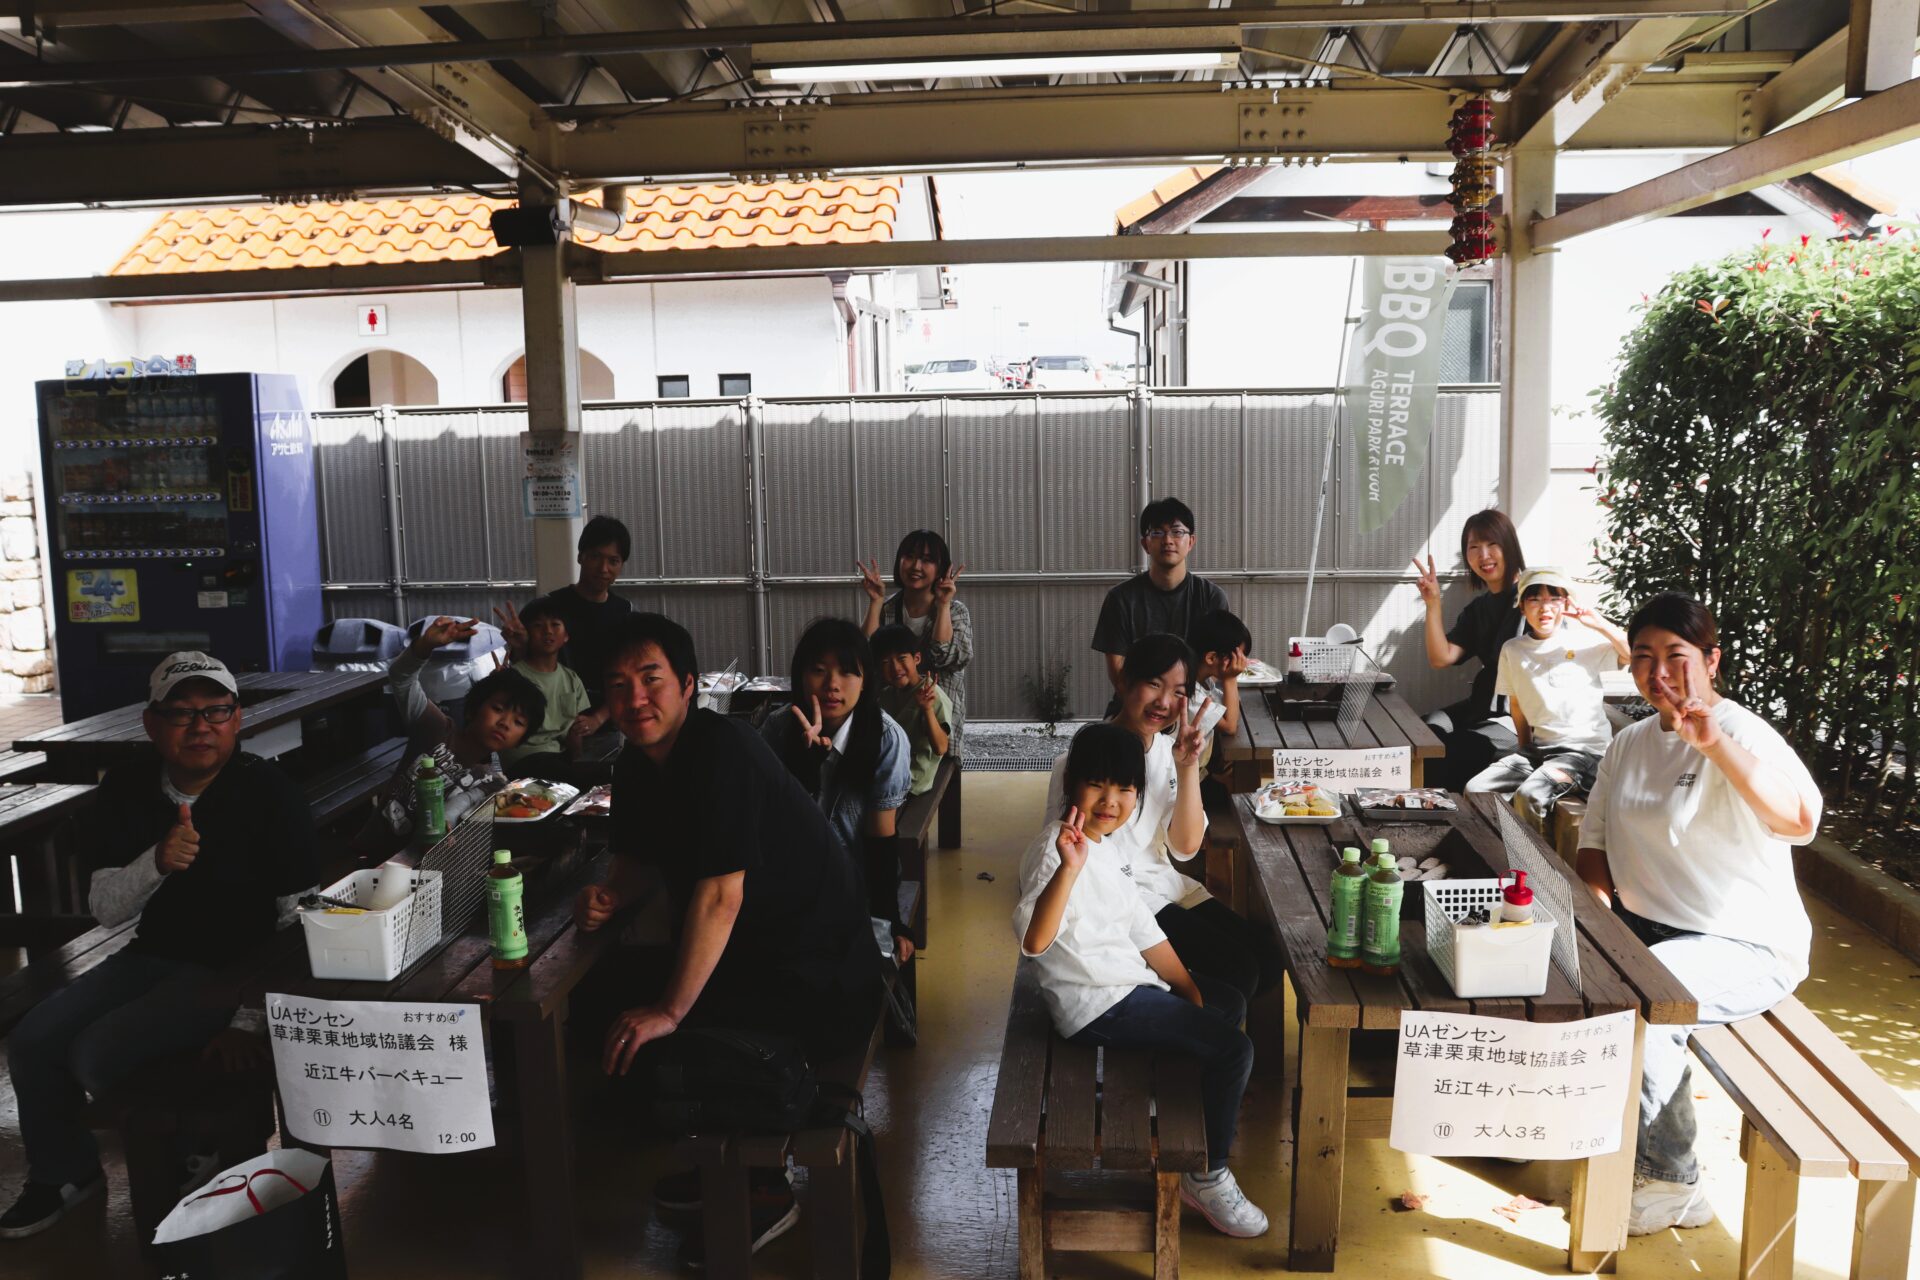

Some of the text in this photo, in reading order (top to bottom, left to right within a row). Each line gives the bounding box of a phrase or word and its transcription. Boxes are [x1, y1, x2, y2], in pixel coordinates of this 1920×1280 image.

[1364, 264, 1435, 358] BBQ
[1368, 369, 1388, 414] AGURI
[1385, 370, 1415, 467] TERRACE
[1368, 418, 1383, 455] PARK
[1276, 757, 1333, 767] UAゼンセン
[1277, 766, 1402, 779] 草津栗東地域協議会 様
[271, 1006, 354, 1028] UAゼンセン
[273, 1025, 468, 1052] 草津栗東地域協議会 様
[1405, 1024, 1506, 1043] UAゼンセン
[1403, 1042, 1618, 1068] 草津栗東地域協議会 様
[305, 1062, 463, 1086] 近江牛バーベキュー
[1434, 1079, 1607, 1098] 近江牛バーベキュー
[349, 1110, 414, 1130] 大人4名
[438, 1132, 476, 1144] 12:00
[1474, 1123, 1546, 1141] 大人3名
